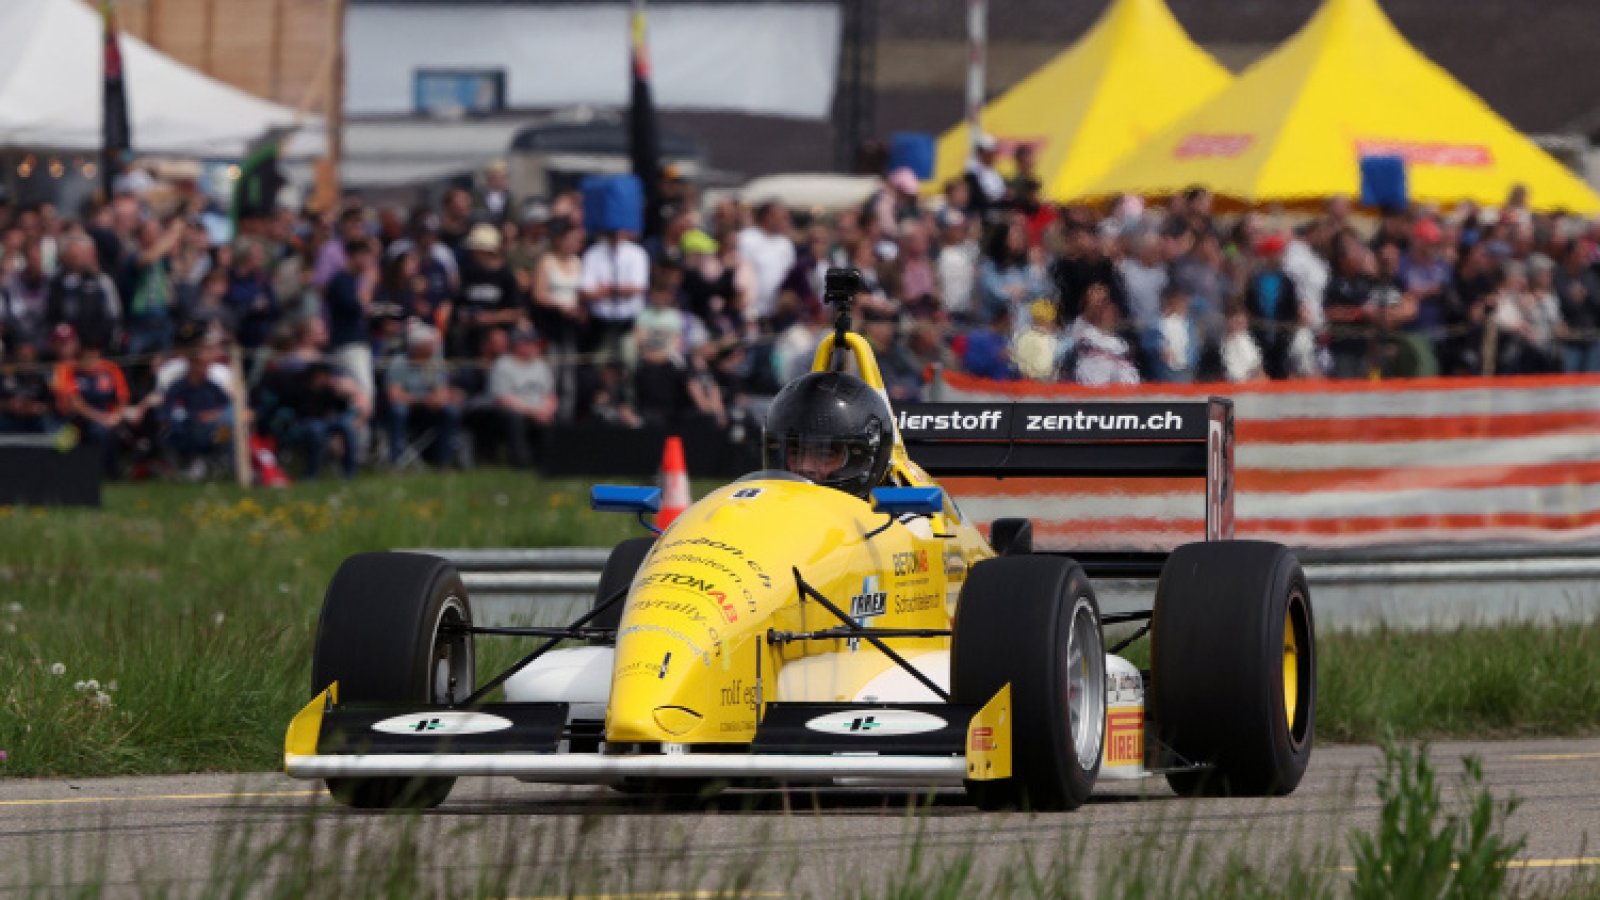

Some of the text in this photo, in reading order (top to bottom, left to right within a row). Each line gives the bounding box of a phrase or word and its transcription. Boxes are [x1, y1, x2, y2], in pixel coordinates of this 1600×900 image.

[896, 410, 1183, 430] ierstoff zentrum.ch
[720, 680, 742, 706] rolf
